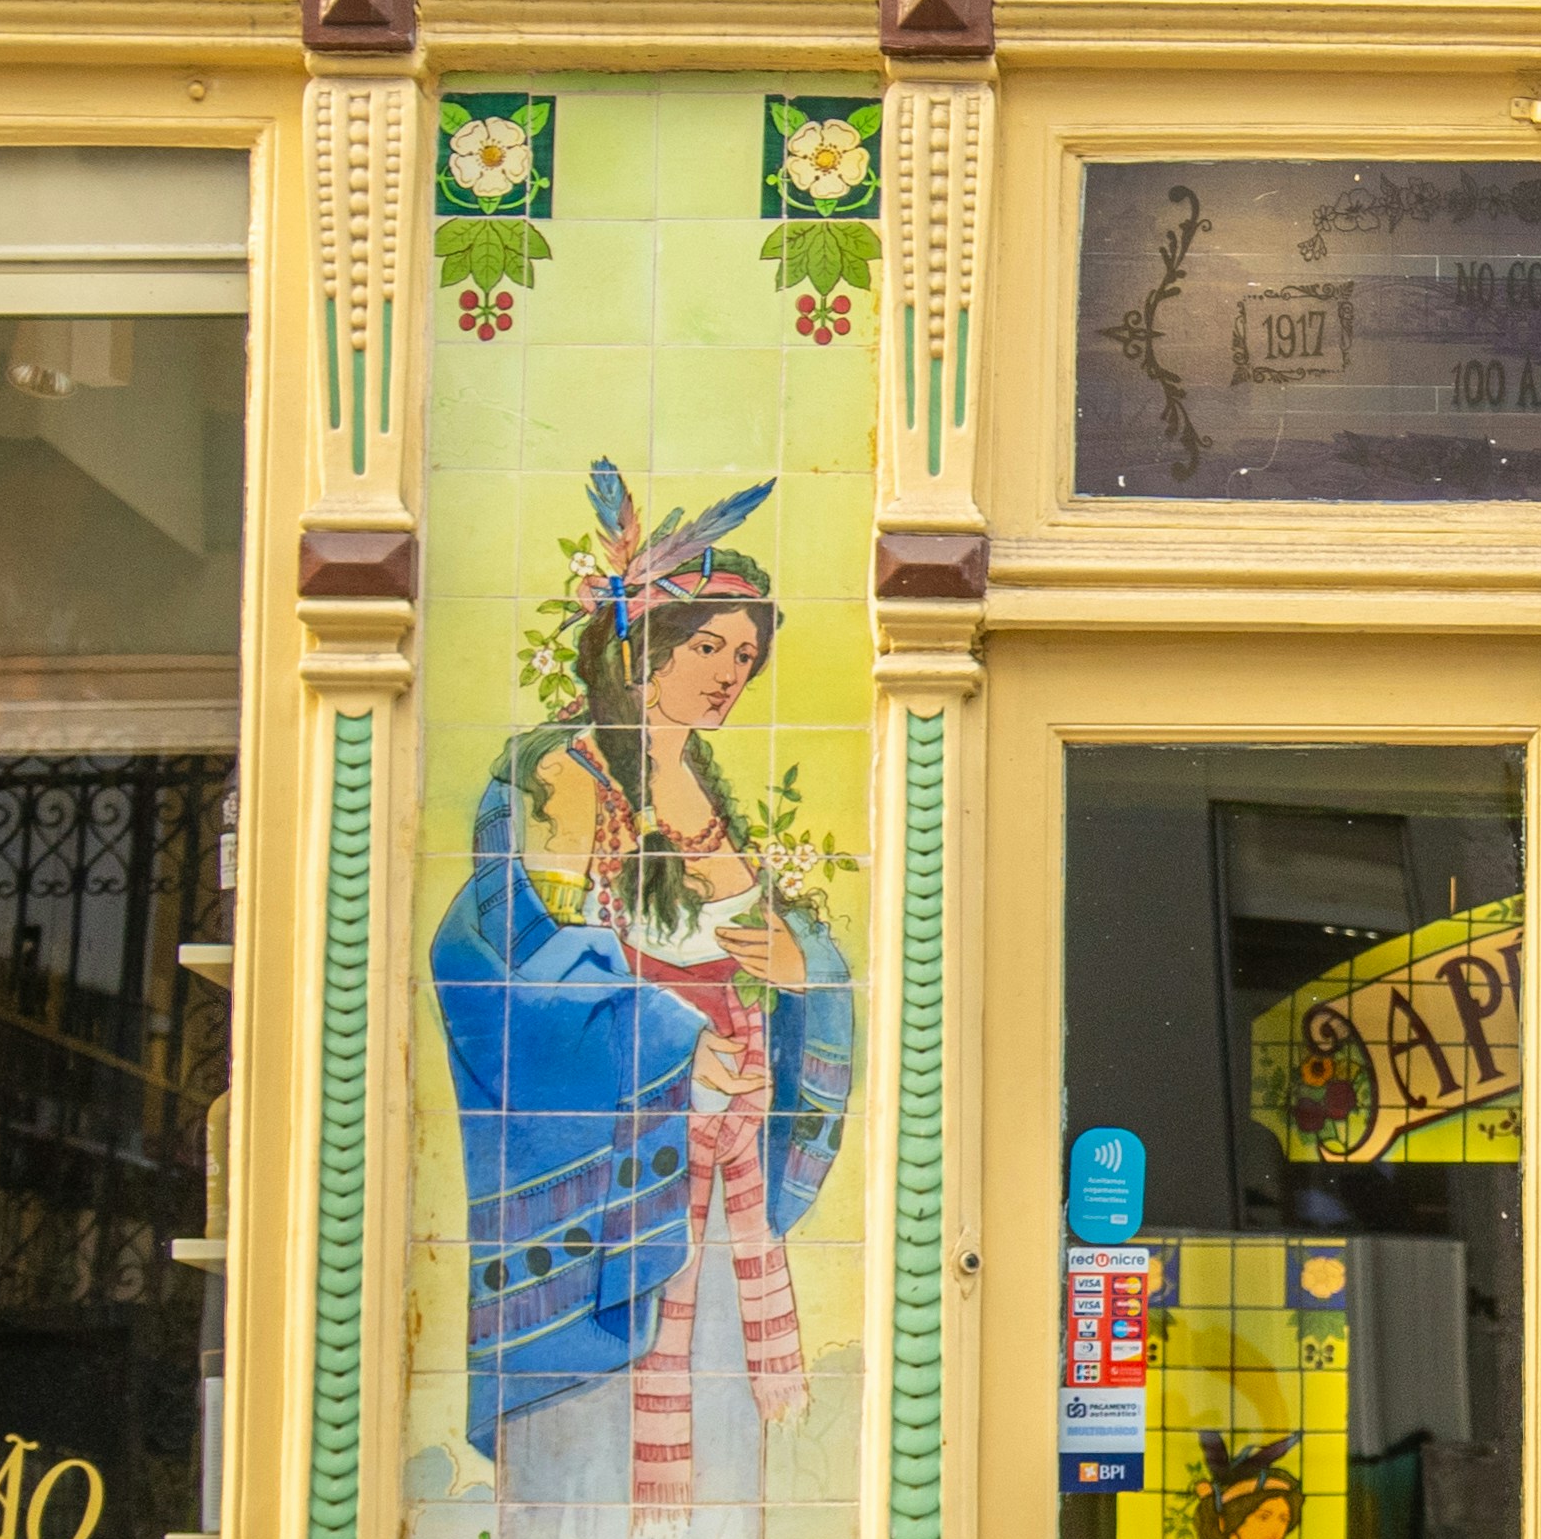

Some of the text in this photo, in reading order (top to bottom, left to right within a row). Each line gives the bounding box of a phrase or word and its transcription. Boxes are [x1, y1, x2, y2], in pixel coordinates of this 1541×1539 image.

[1454, 260, 1495, 310] NO
[1260, 309, 1328, 362] 1917
[1449, 359, 1506, 408] 100
[1386, 986, 1462, 1110] A
[1077, 1279, 1101, 1288] VISA
[1078, 1301, 1101, 1310] VISA
[1099, 1464, 1126, 1480] BPI
